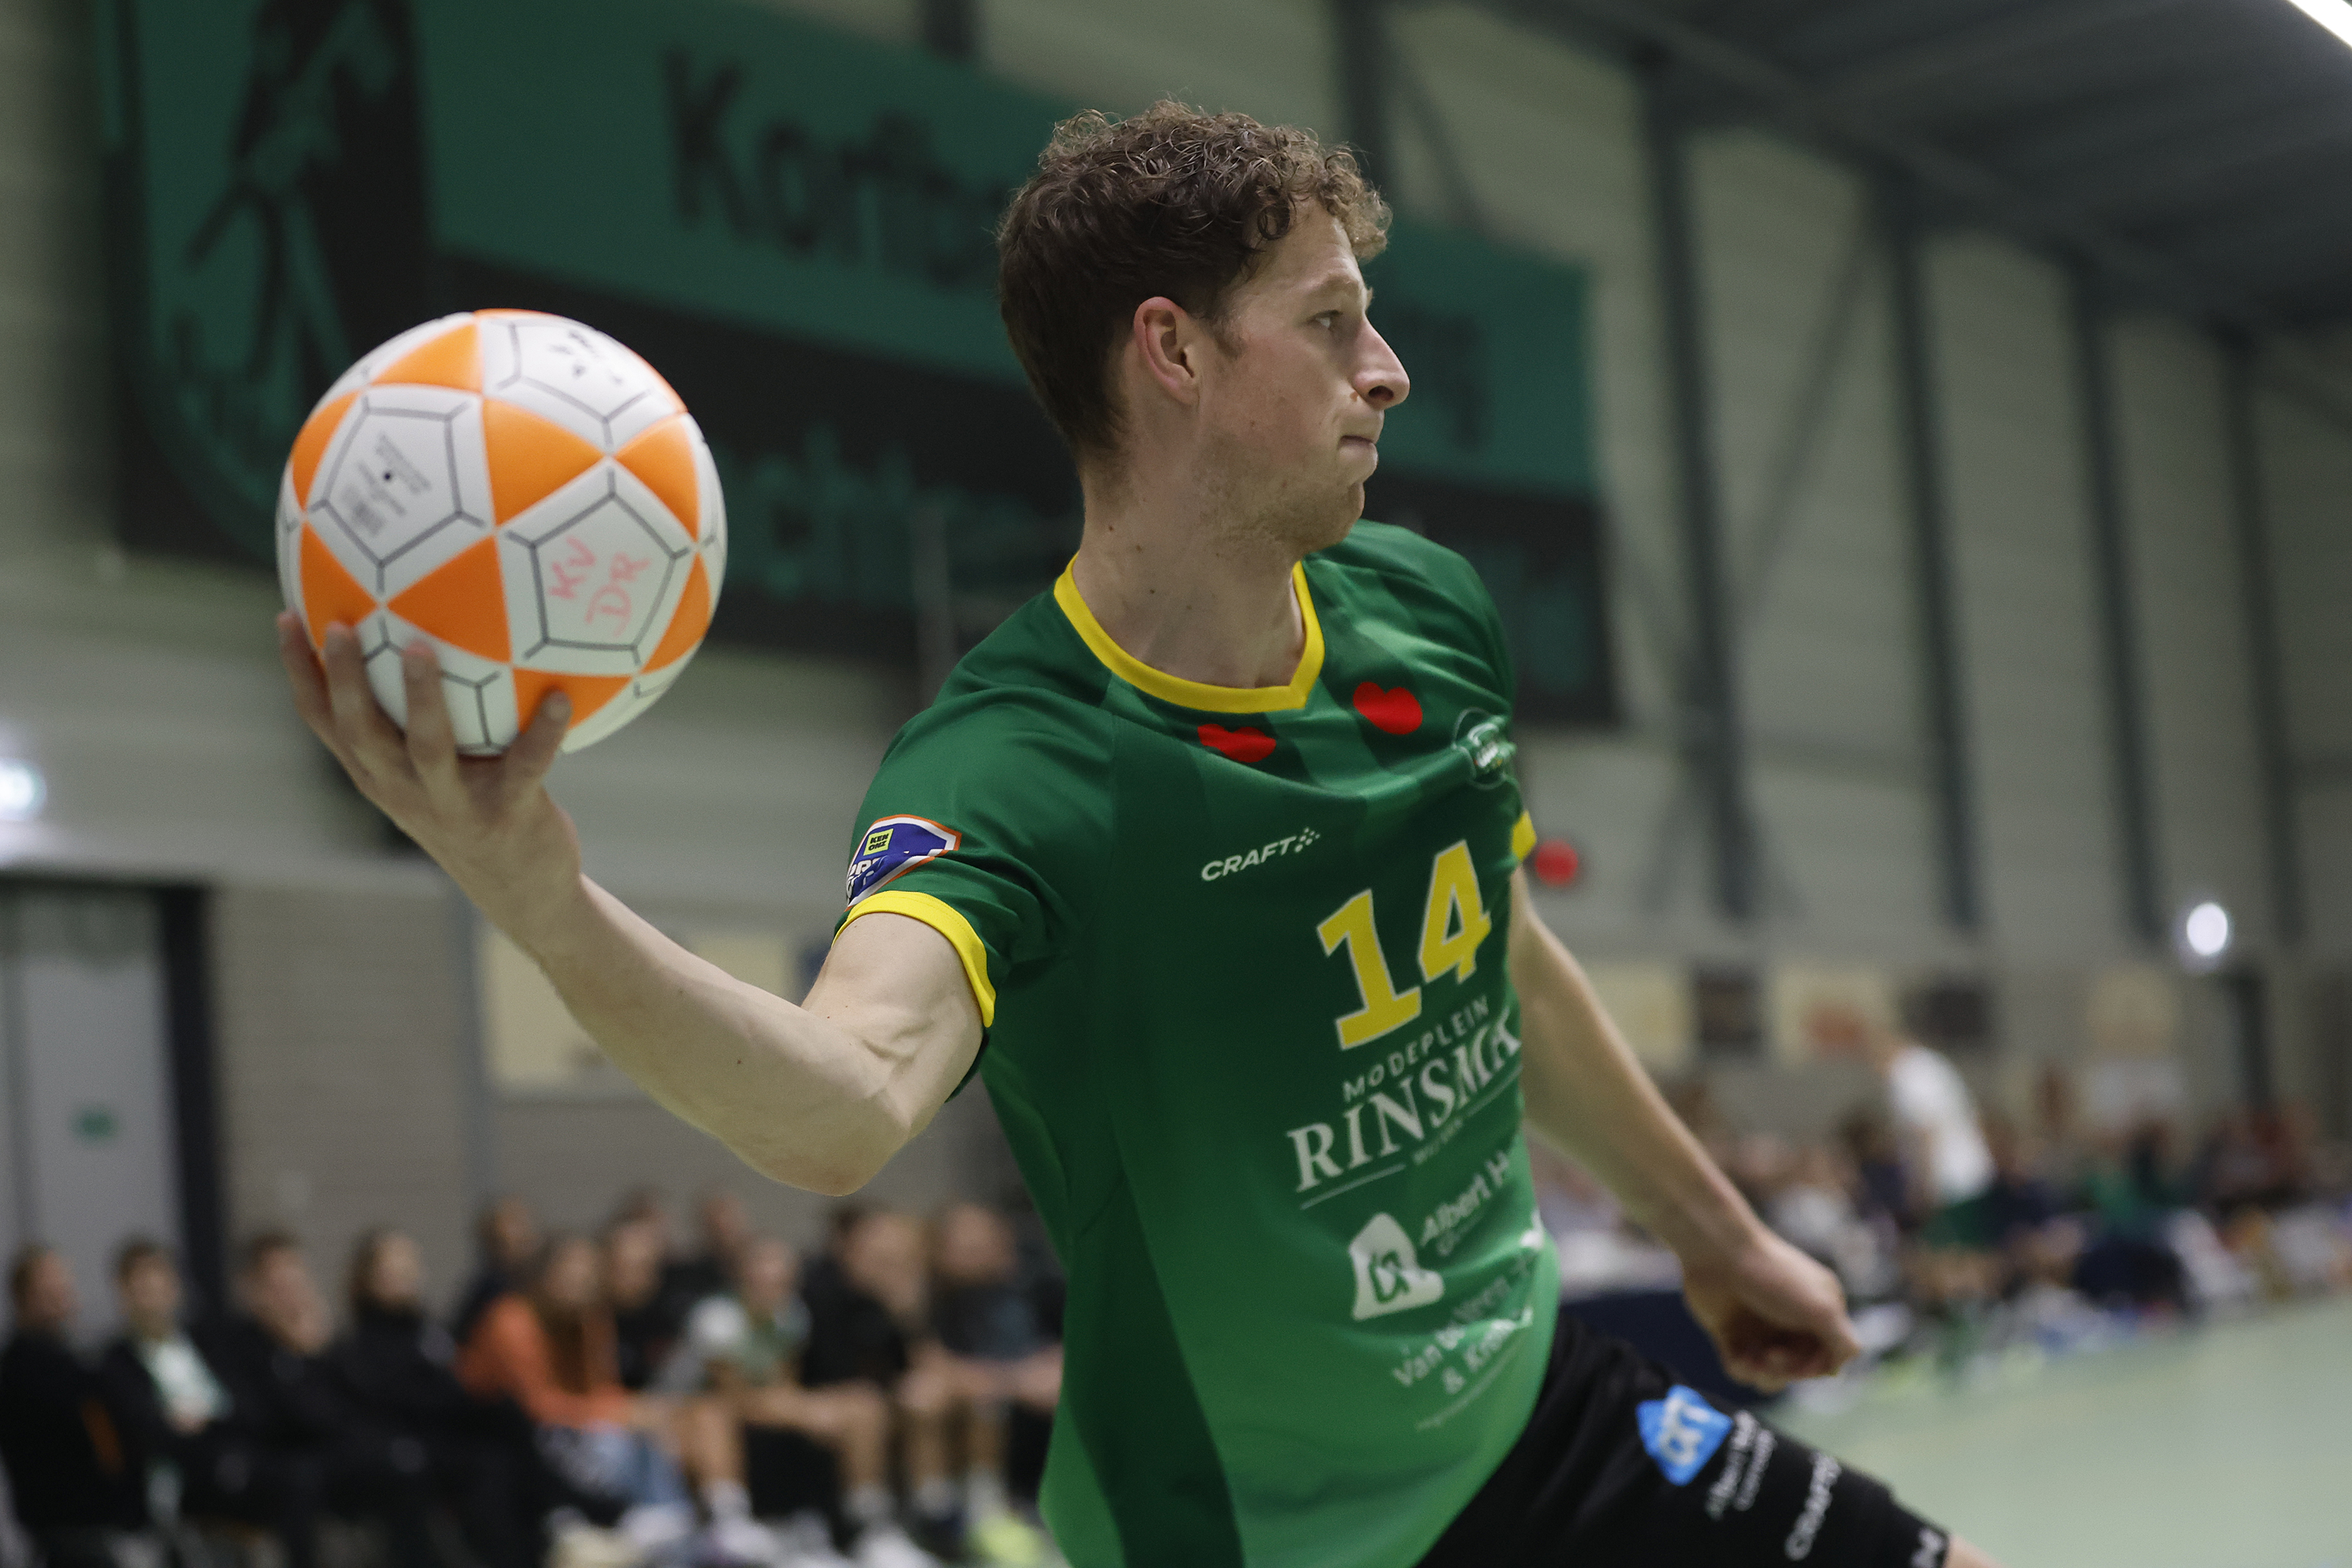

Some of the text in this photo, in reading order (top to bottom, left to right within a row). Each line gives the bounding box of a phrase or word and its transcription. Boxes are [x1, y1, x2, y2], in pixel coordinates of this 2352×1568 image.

[549, 535, 597, 599] KV
[1202, 836, 1298, 881] CRAFT
[1316, 839, 1492, 1049] 14
[1343, 995, 1489, 1102] MODEPLEIN
